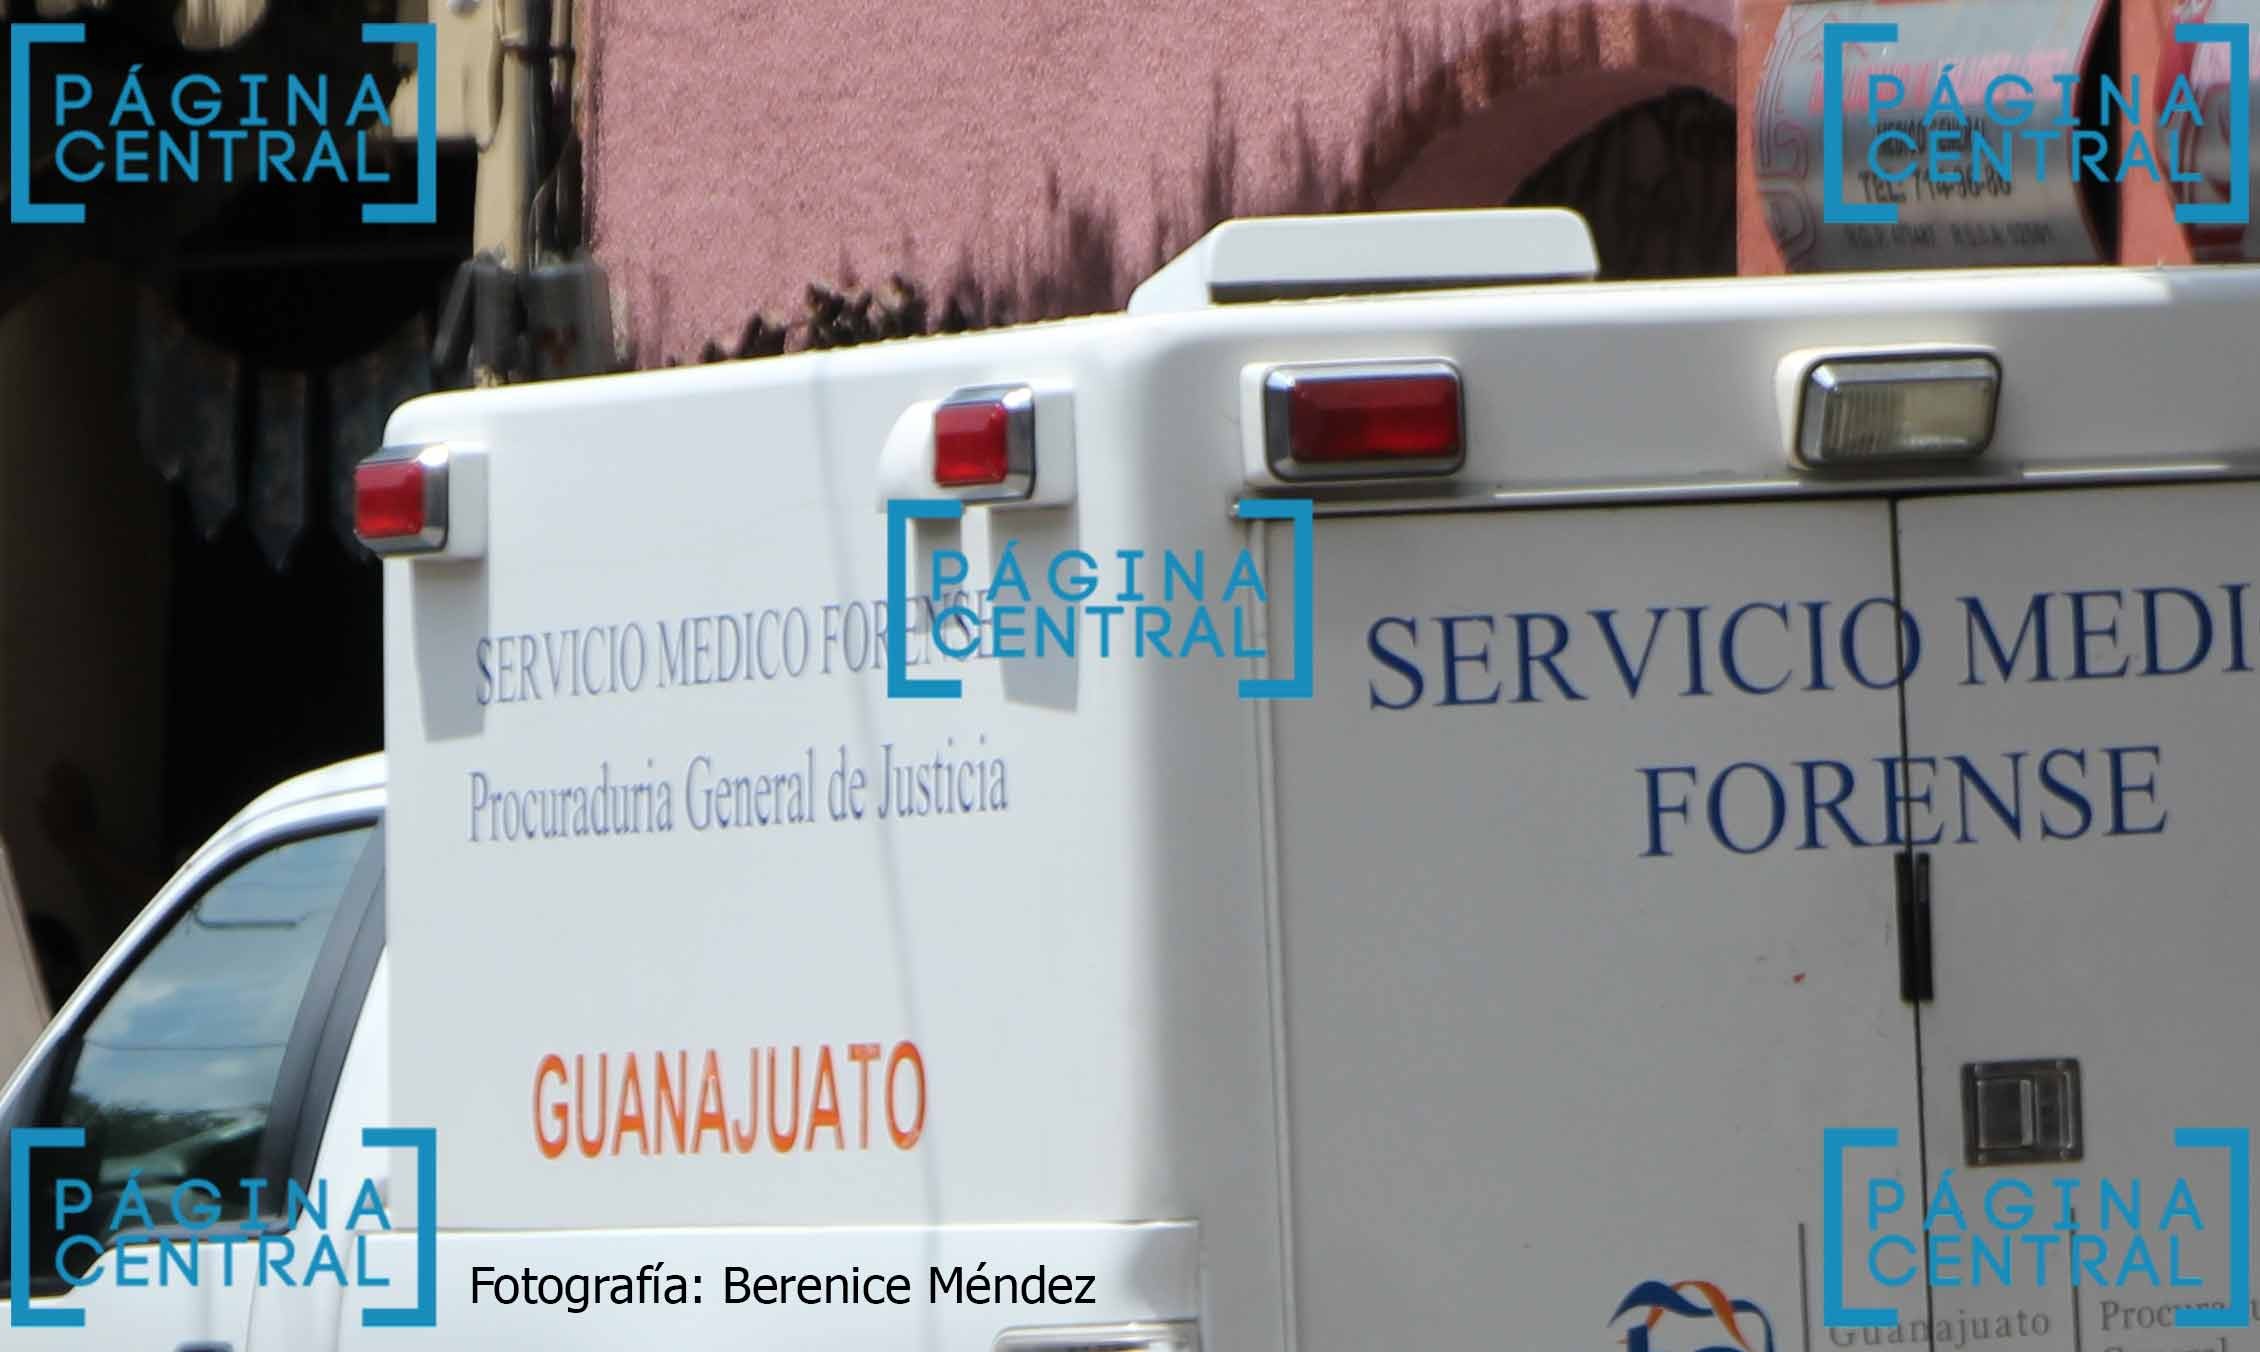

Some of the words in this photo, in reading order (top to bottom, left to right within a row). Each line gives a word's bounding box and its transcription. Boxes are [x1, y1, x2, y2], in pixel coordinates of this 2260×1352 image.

[475, 622, 647, 706] SERVICIO
[656, 606, 809, 688] MEDICO
[1366, 597, 1922, 710] SERVICIO
[1956, 582, 2260, 687] MEDI
[467, 760, 674, 842] Procuraduria
[685, 746, 815, 832] General
[827, 745, 867, 821] de
[877, 736, 1009, 820] Justicia
[1637, 745, 2169, 857] FORENSE
[533, 1041, 927, 1159] GUANAJUATO
[1828, 1309, 2050, 1350] Guanajuato
